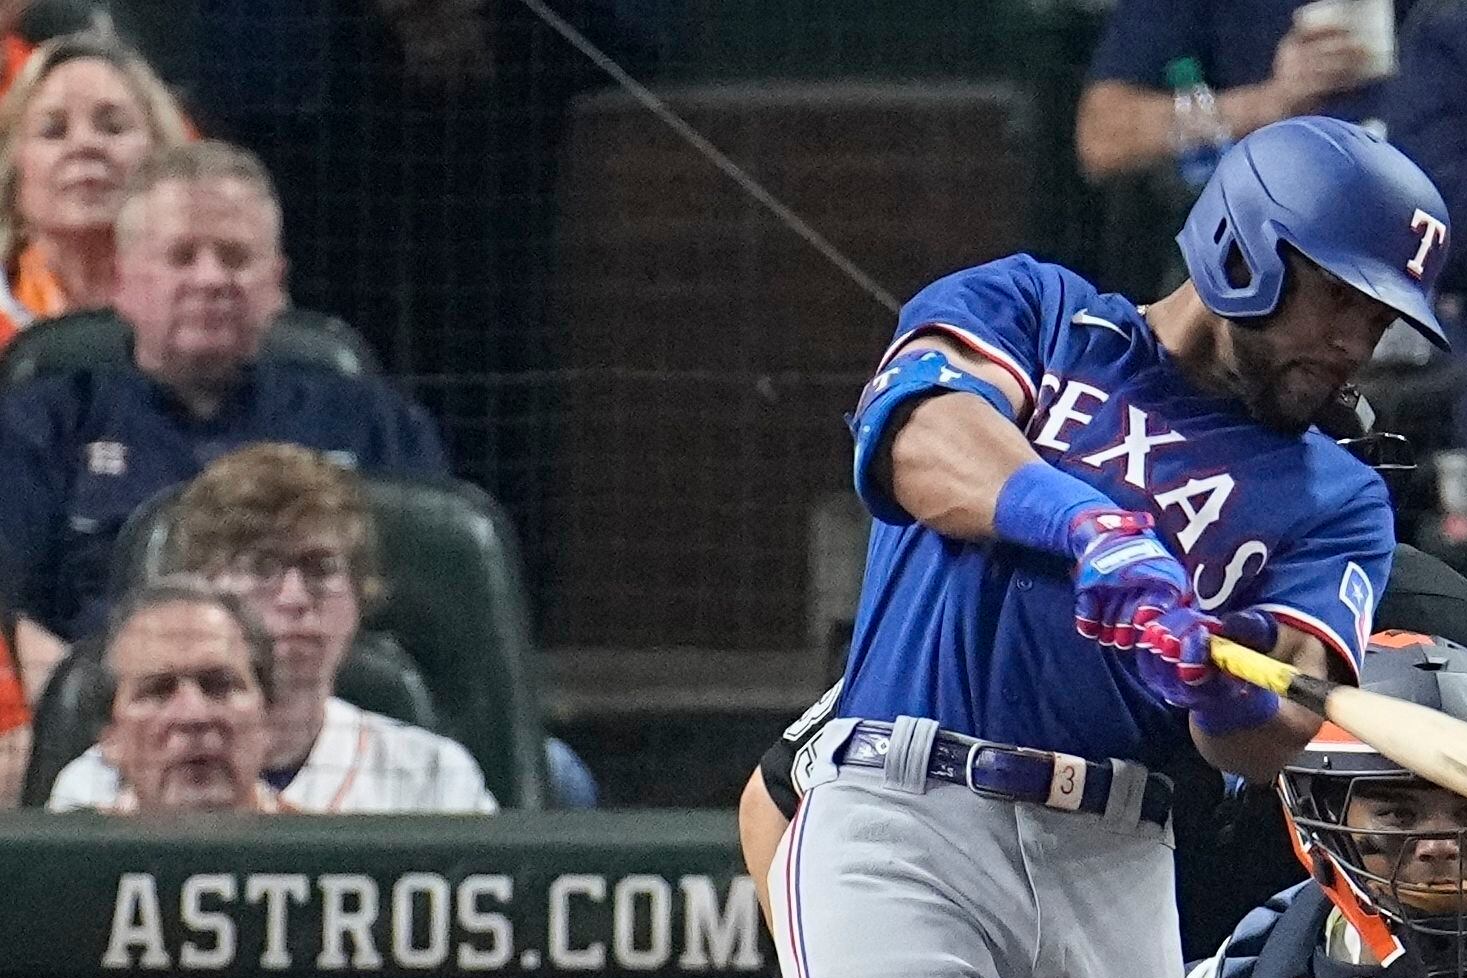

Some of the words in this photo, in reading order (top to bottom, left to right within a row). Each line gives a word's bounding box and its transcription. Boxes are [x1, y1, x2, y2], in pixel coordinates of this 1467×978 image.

[1407, 208, 1447, 276] T
[1060, 765, 1075, 795] 3
[102, 872, 765, 971] ASTROS.COM
